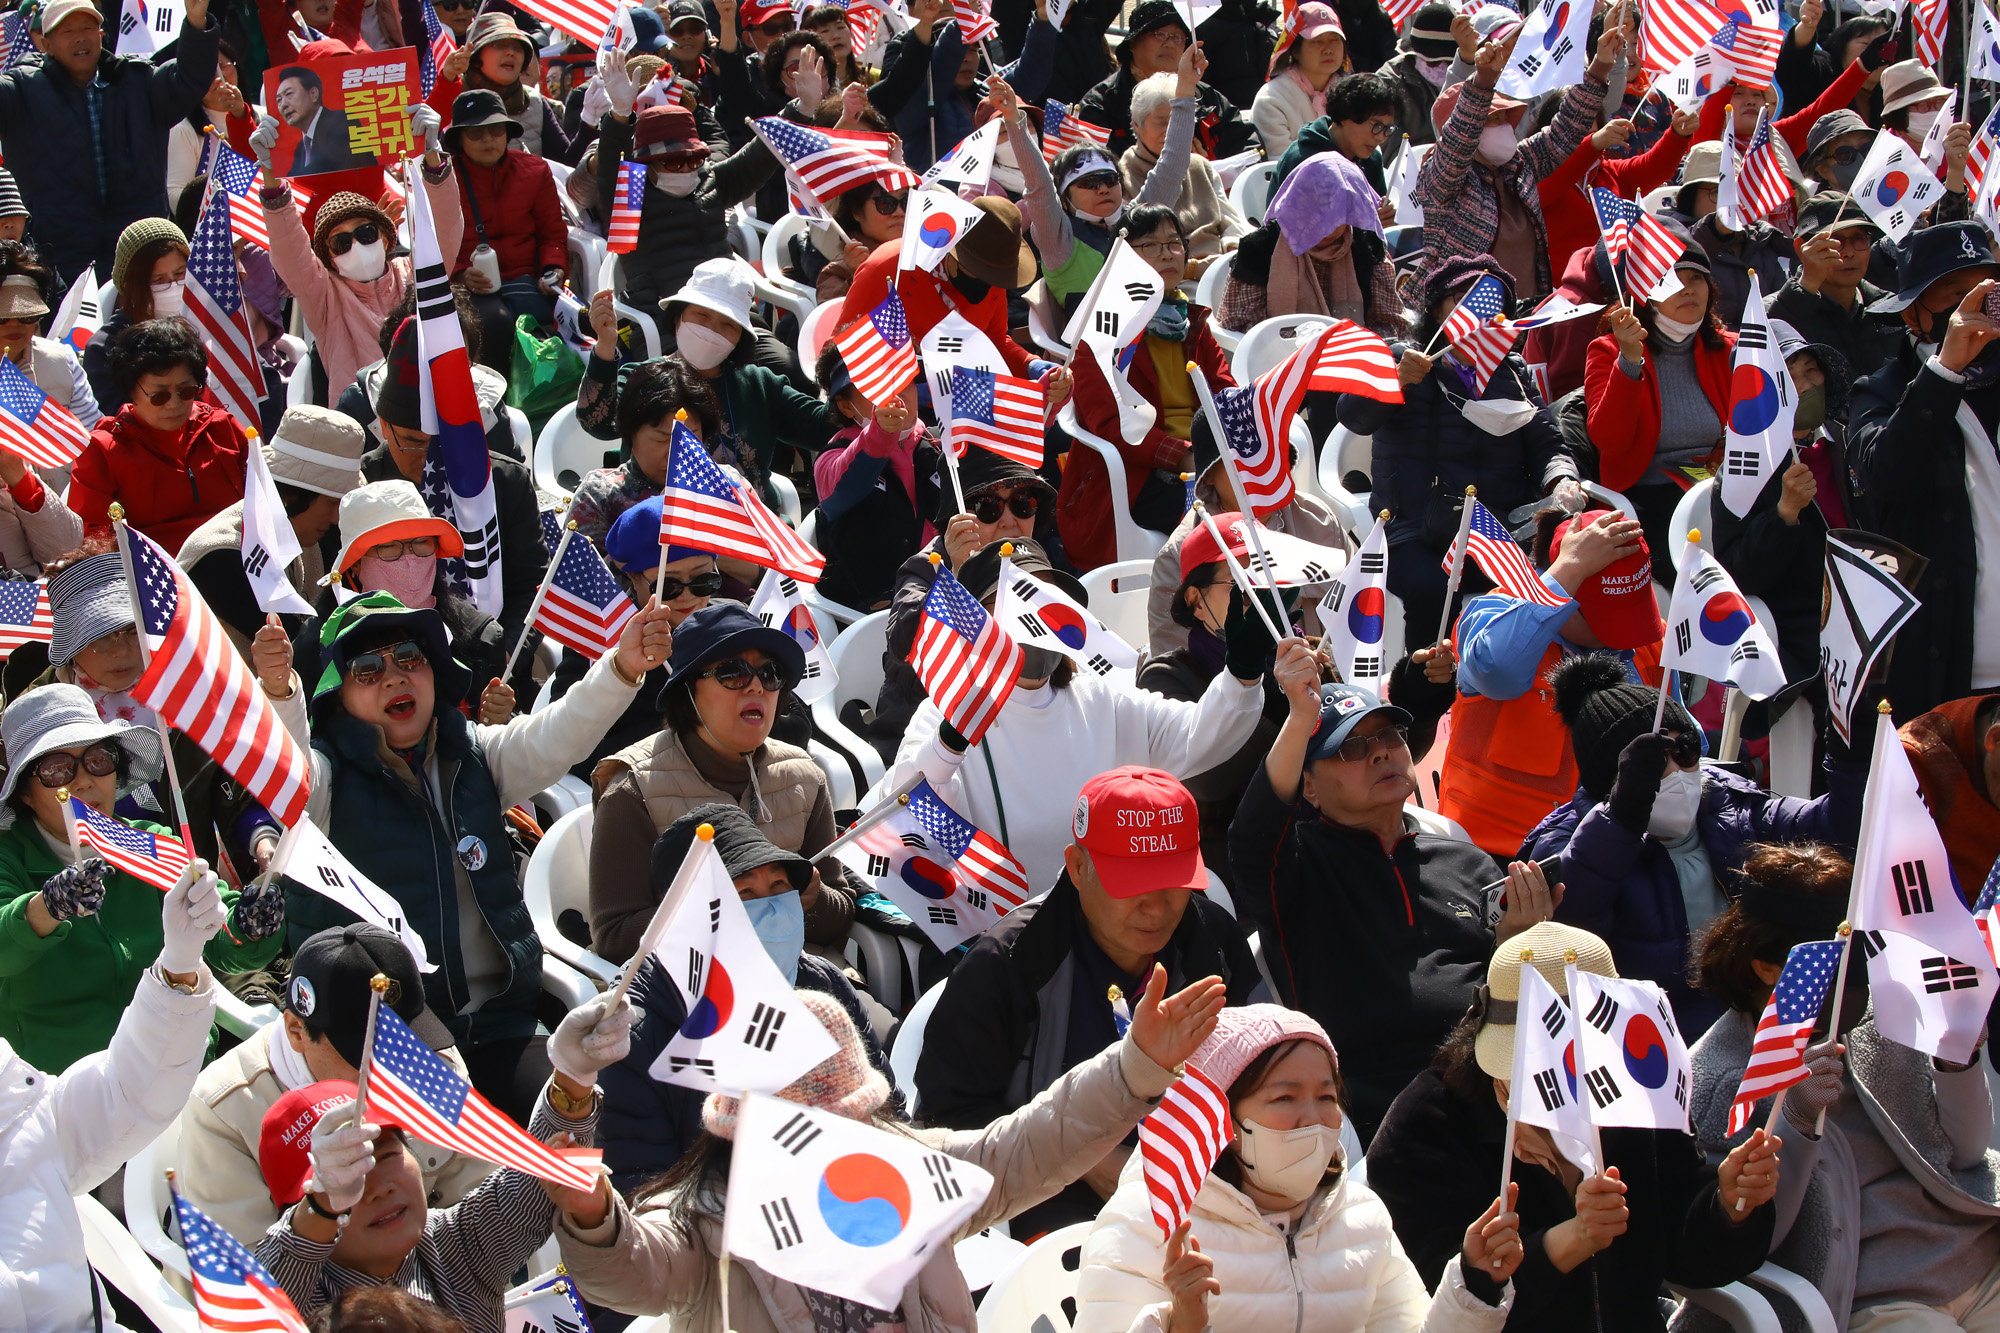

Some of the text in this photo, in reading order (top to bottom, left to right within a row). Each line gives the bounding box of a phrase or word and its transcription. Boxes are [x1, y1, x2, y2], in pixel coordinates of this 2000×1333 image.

[342, 62, 406, 89] 윤석열
[344, 85, 411, 123] 즉각
[348, 118, 415, 156] 복귀
[1601, 561, 1651, 585] MAKE KOREA
[1602, 585, 1634, 595] GREAT
[1117, 806, 1184, 828] STOP THE
[1130, 833, 1177, 853] STEAL
[281, 1093, 354, 1146] MAKE KOREA
[296, 1130, 312, 1150] GRE
